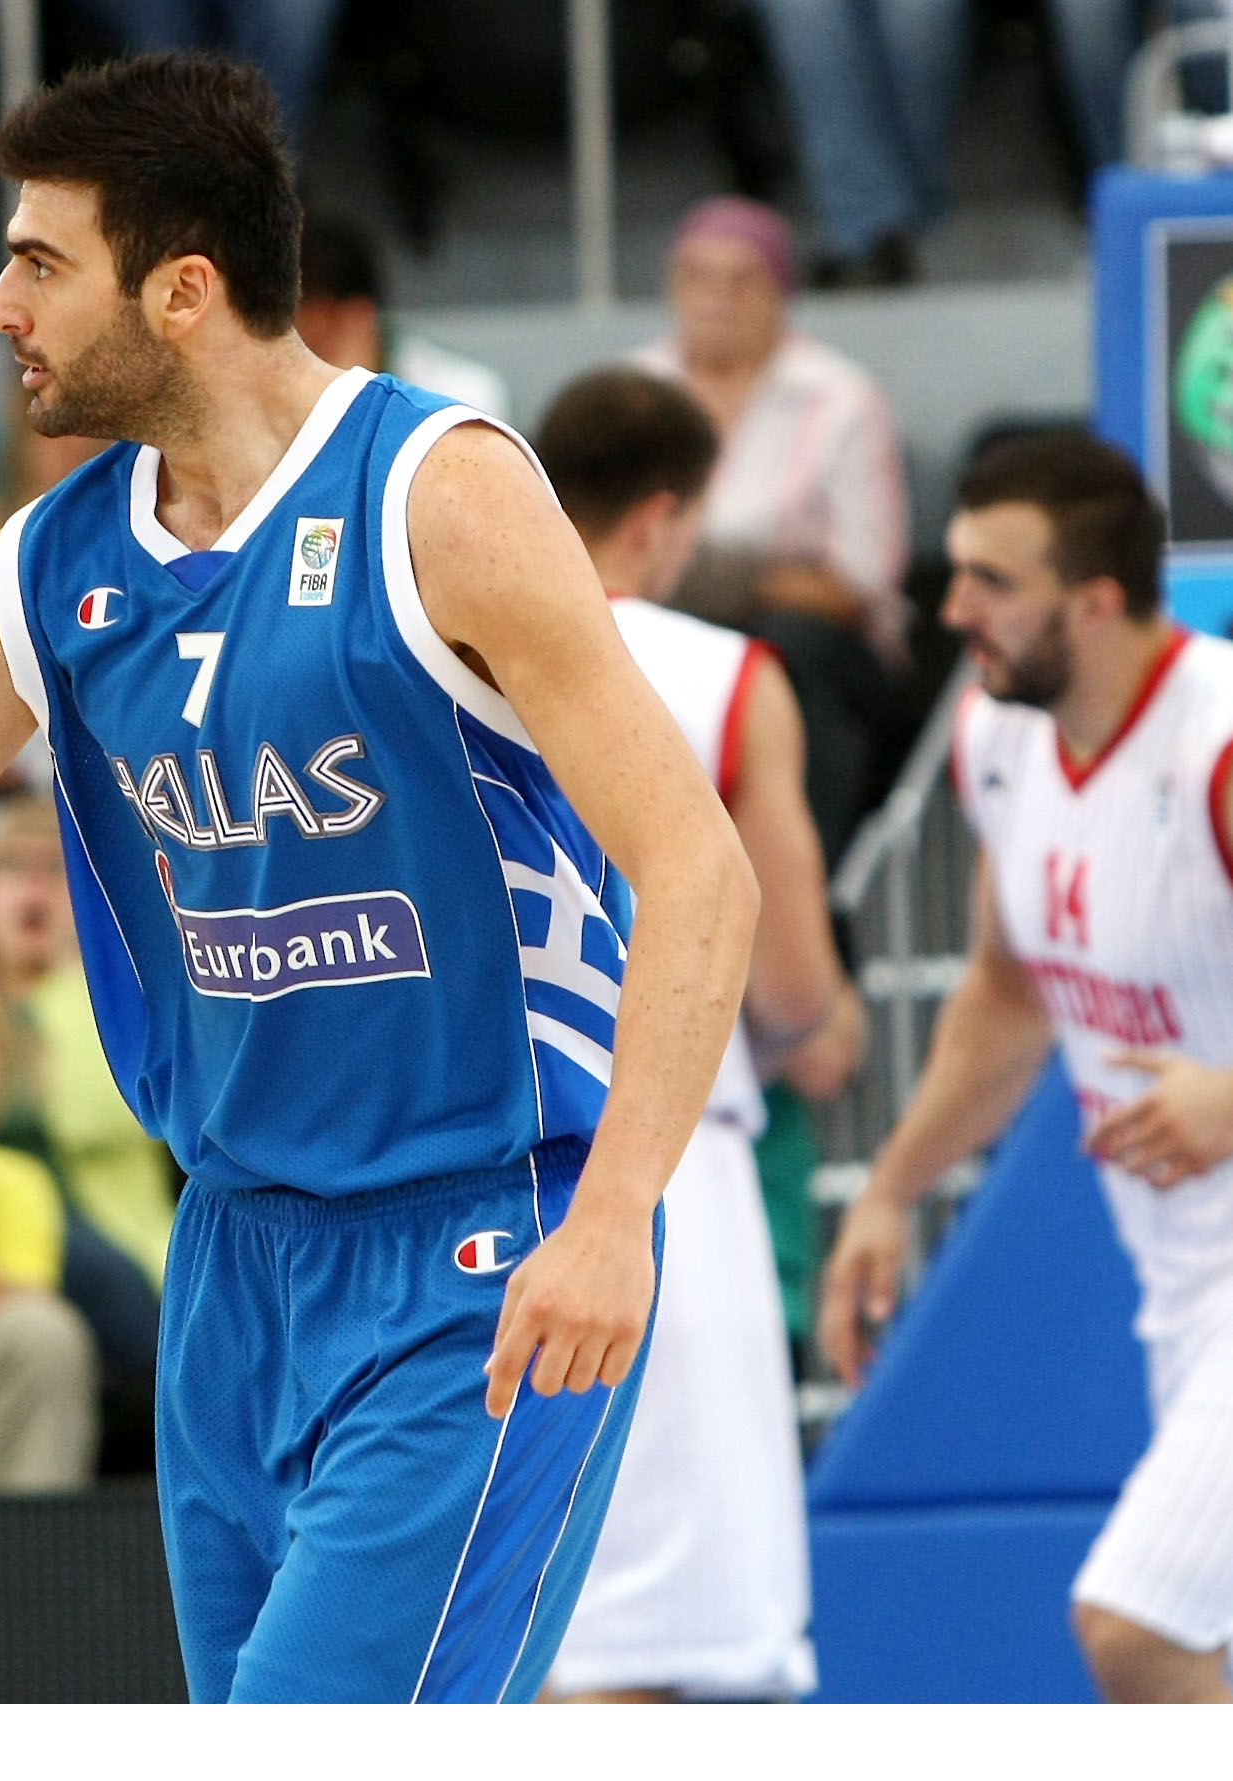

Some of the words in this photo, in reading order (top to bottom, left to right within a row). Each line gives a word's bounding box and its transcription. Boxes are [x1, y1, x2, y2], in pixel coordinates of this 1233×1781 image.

[299, 573, 328, 591] FIBA
[175, 631, 227, 729] 7
[184, 913, 398, 981] Eurbank
